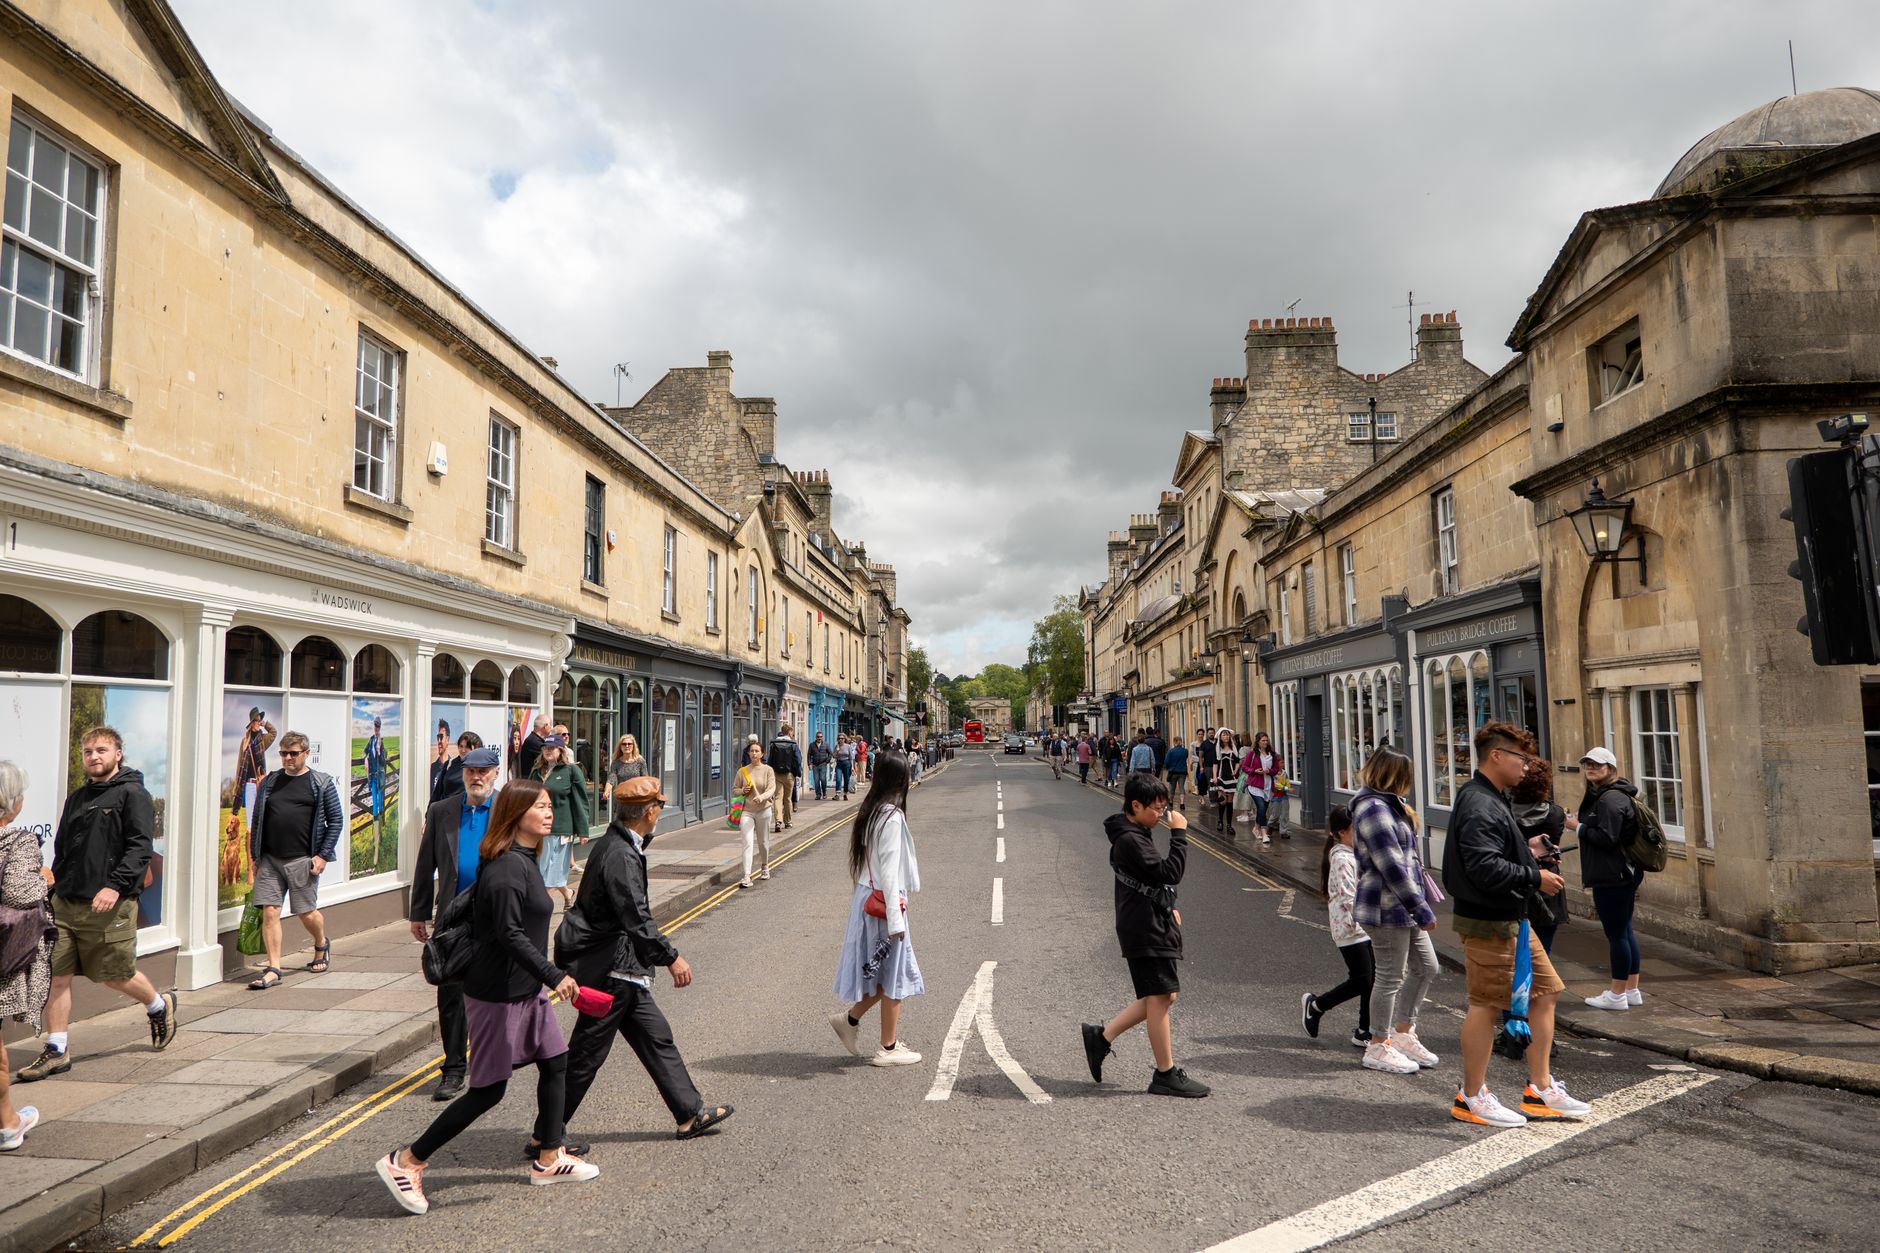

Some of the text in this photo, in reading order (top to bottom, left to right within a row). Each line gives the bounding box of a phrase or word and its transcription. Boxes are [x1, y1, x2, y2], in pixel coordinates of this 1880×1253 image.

[10, 522, 17, 550] 1
[321, 593, 372, 614] WADSWICK
[1426, 615, 1517, 647] PULTENEY BRIDGE COFFEE
[576, 645, 637, 669] ICARUS JEWELLERY
[1281, 648, 1343, 674] PULTENEY BRIDGE COFFEE
